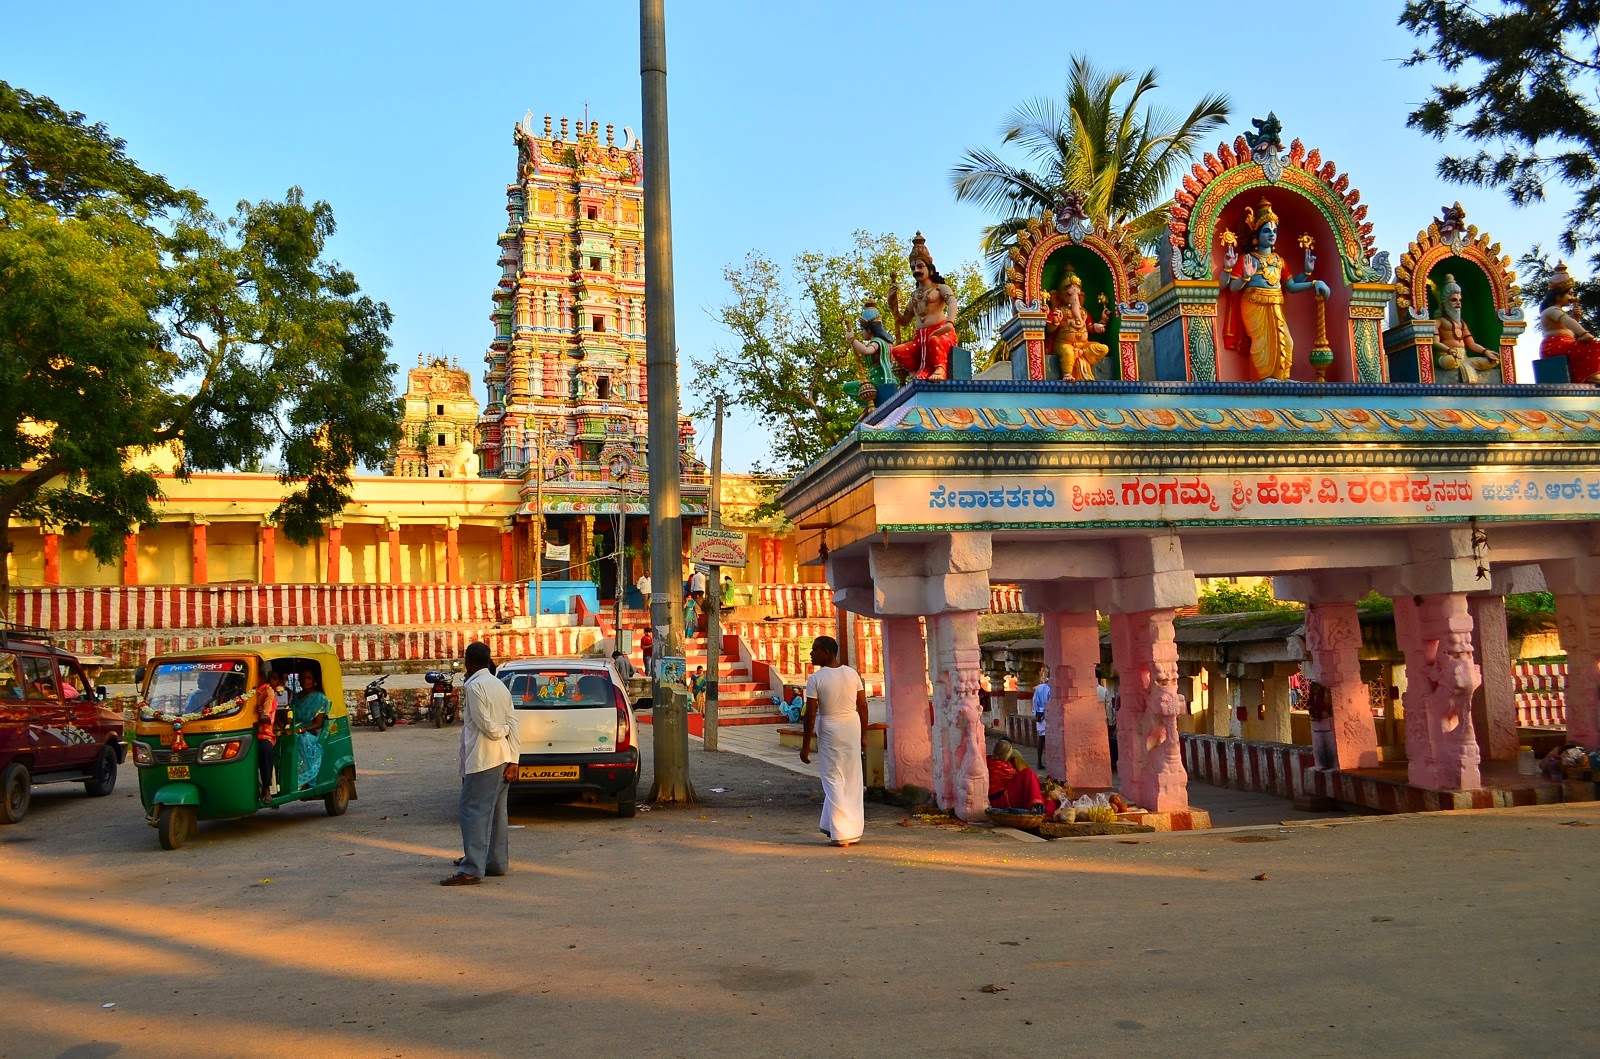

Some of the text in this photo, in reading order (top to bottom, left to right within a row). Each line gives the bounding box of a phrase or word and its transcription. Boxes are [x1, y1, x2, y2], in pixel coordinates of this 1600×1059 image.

[929, 485, 1055, 508] ಸೇವಾಕರ್ತರು
[1121, 476, 1220, 512] ಗಂಗಮ್ಮ
[1230, 479, 1253, 512] ಶ್ರೀ
